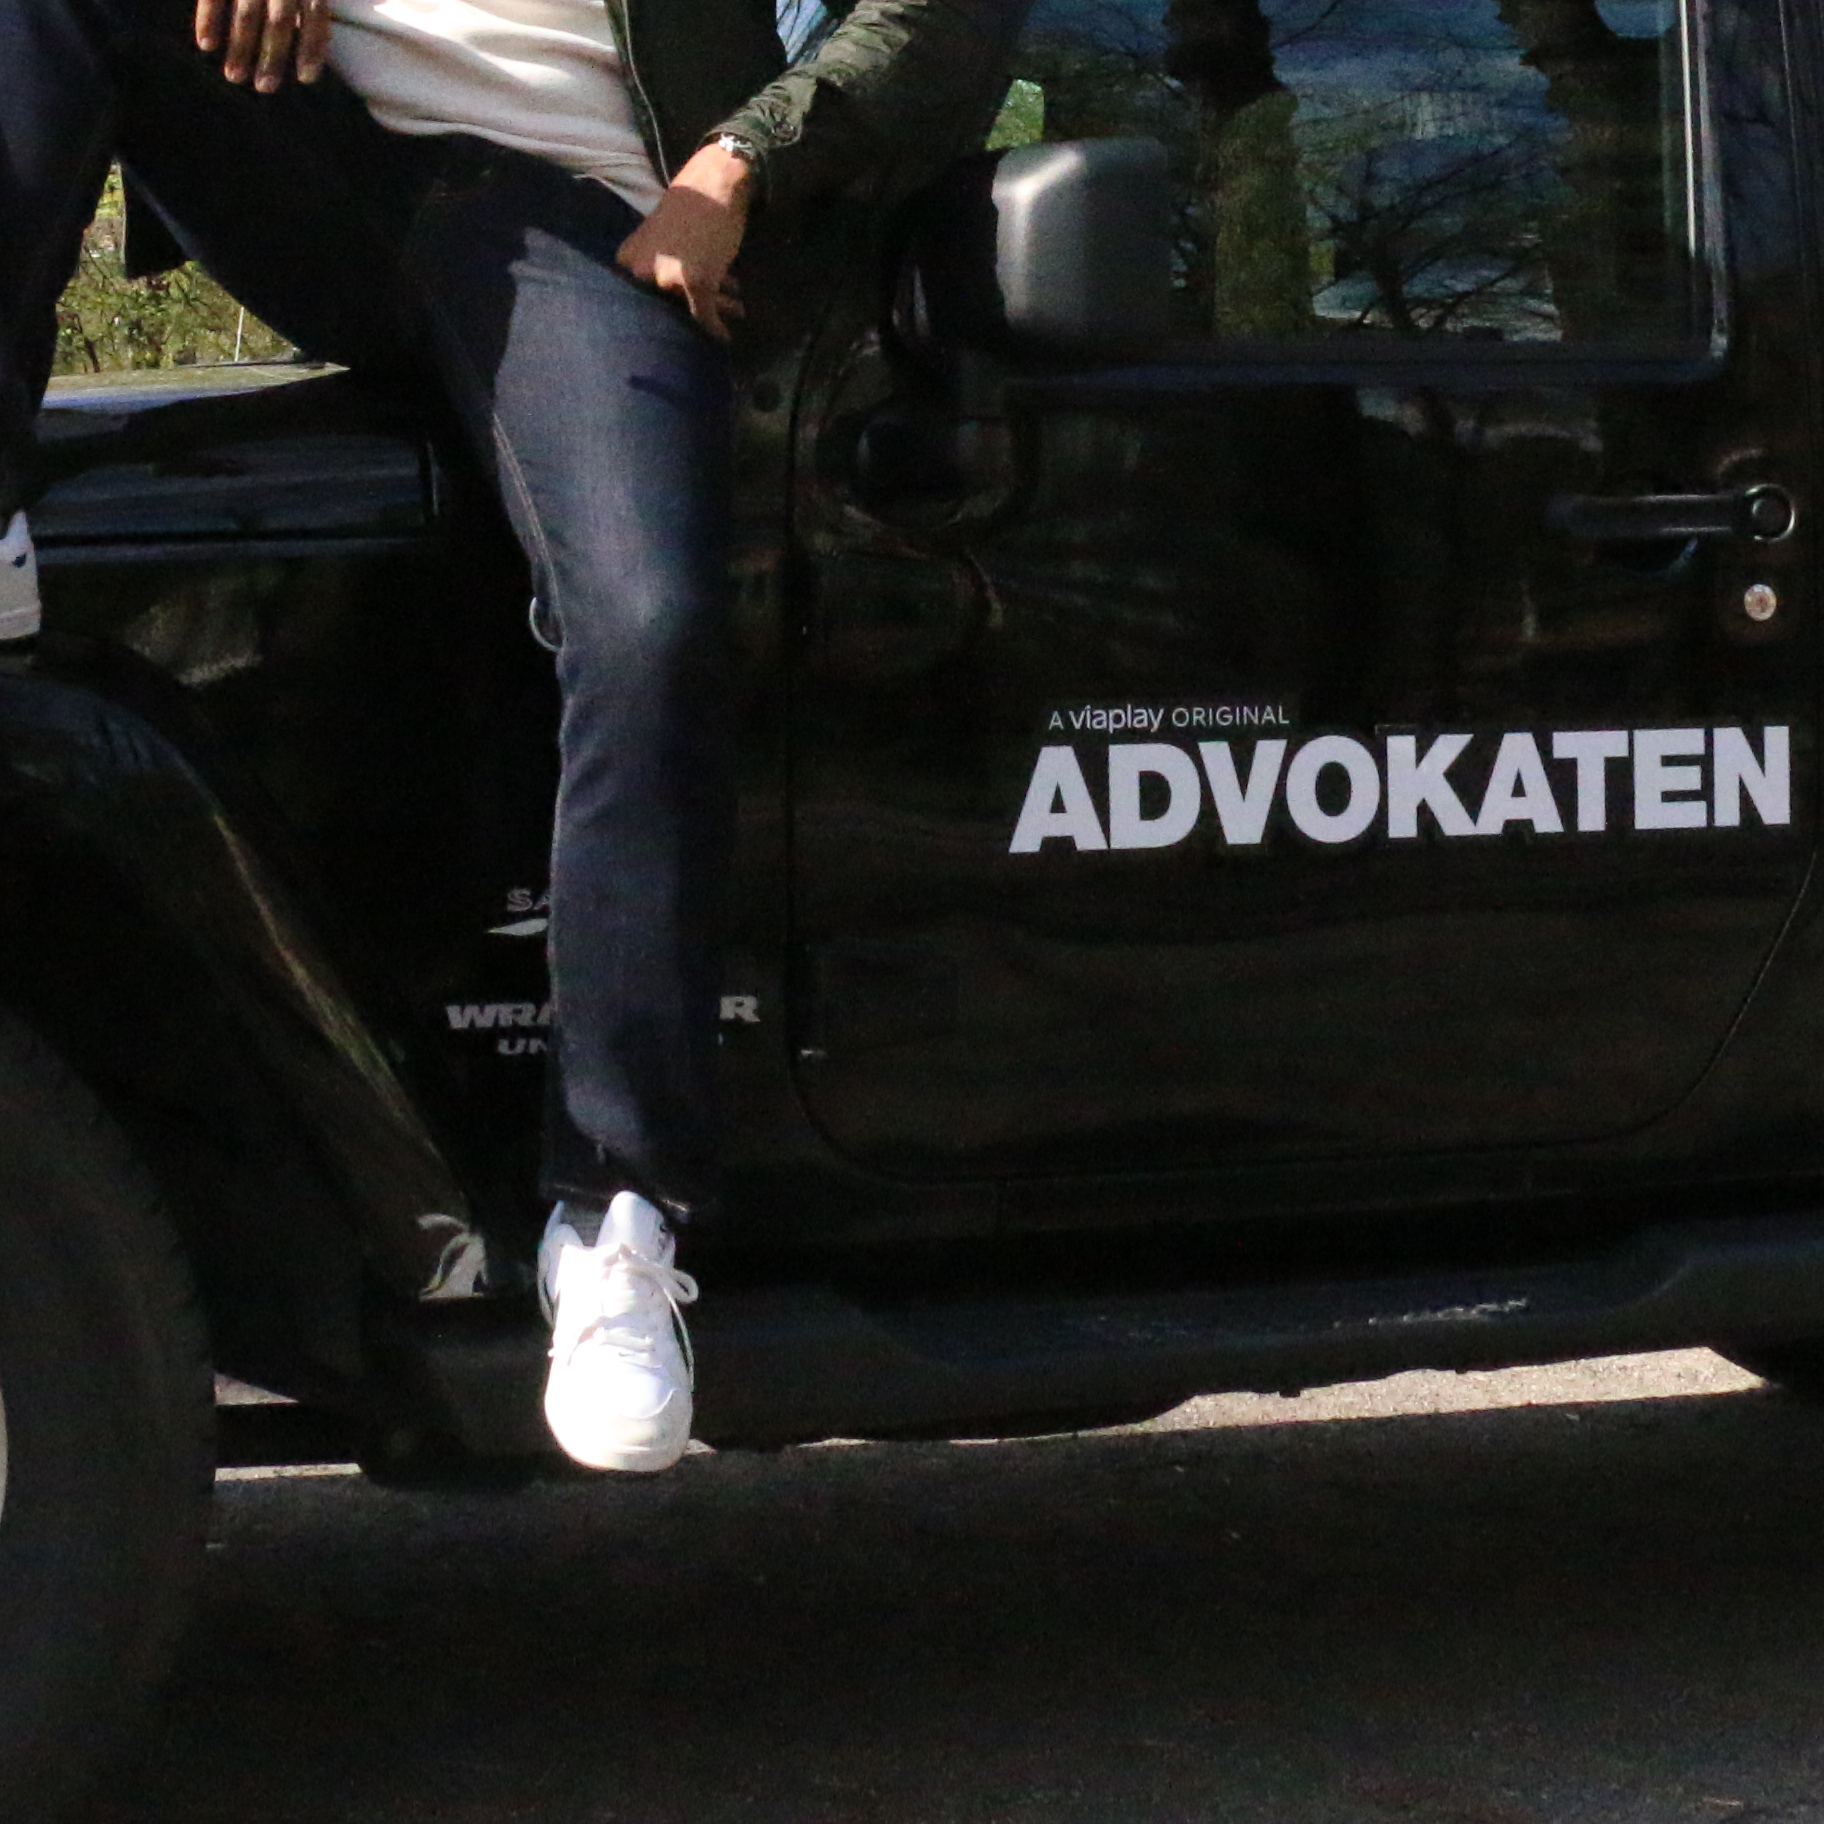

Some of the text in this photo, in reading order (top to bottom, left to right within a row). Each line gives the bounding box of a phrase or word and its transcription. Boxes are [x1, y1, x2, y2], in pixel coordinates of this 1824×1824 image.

[1048, 704, 1291, 734] A viaplay ORIGINAL
[1008, 725, 1792, 853] ADVOKATEN
